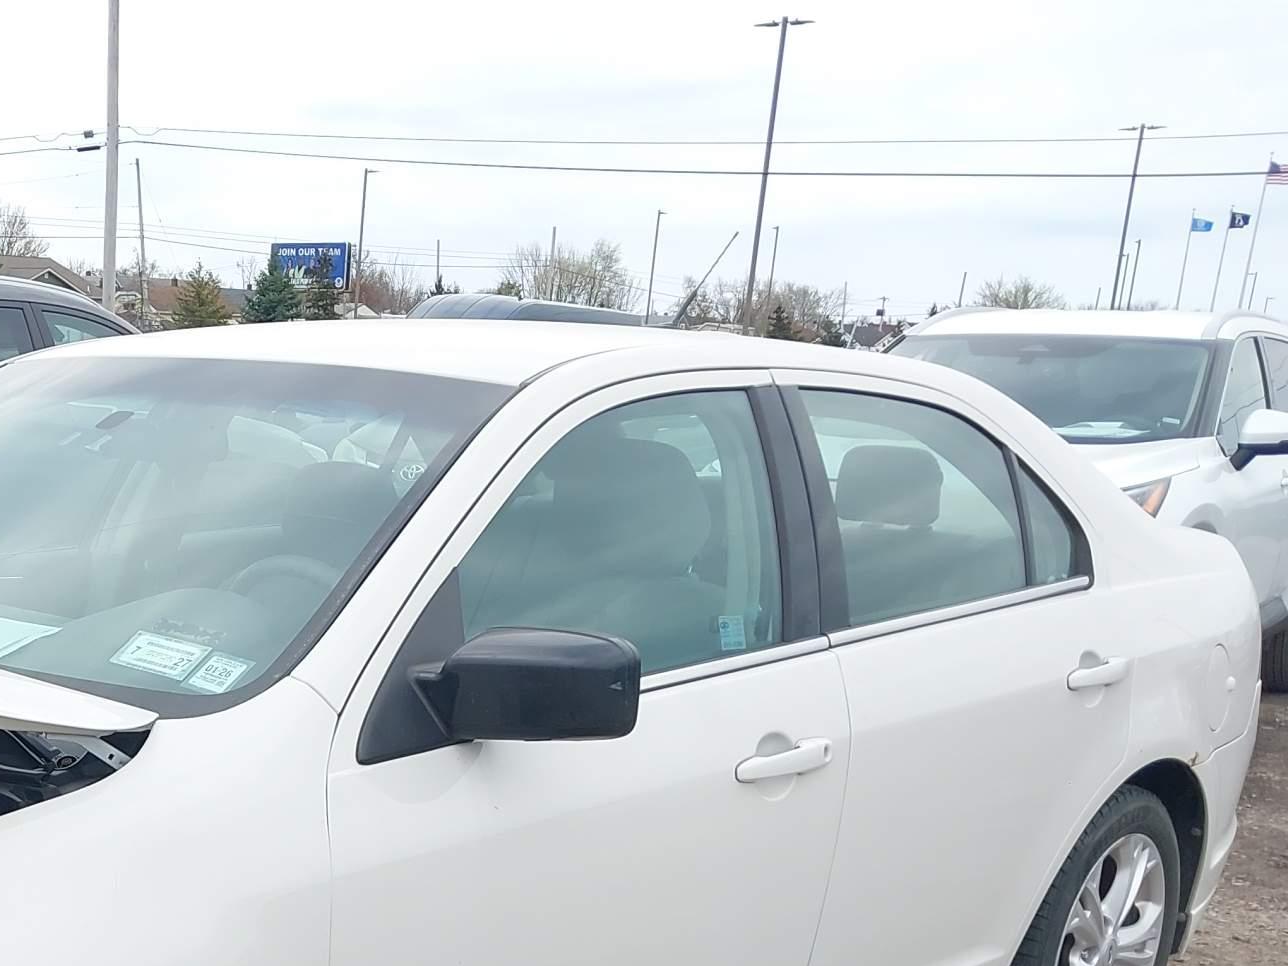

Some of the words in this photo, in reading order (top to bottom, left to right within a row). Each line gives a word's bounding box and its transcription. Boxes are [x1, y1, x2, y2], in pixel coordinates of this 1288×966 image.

[278, 247, 296, 256] JOIN
[298, 247, 316, 256] OUR
[318, 247, 341, 256] TEAM
[131, 645, 142, 654] 7
[172, 657, 192, 667] 27
